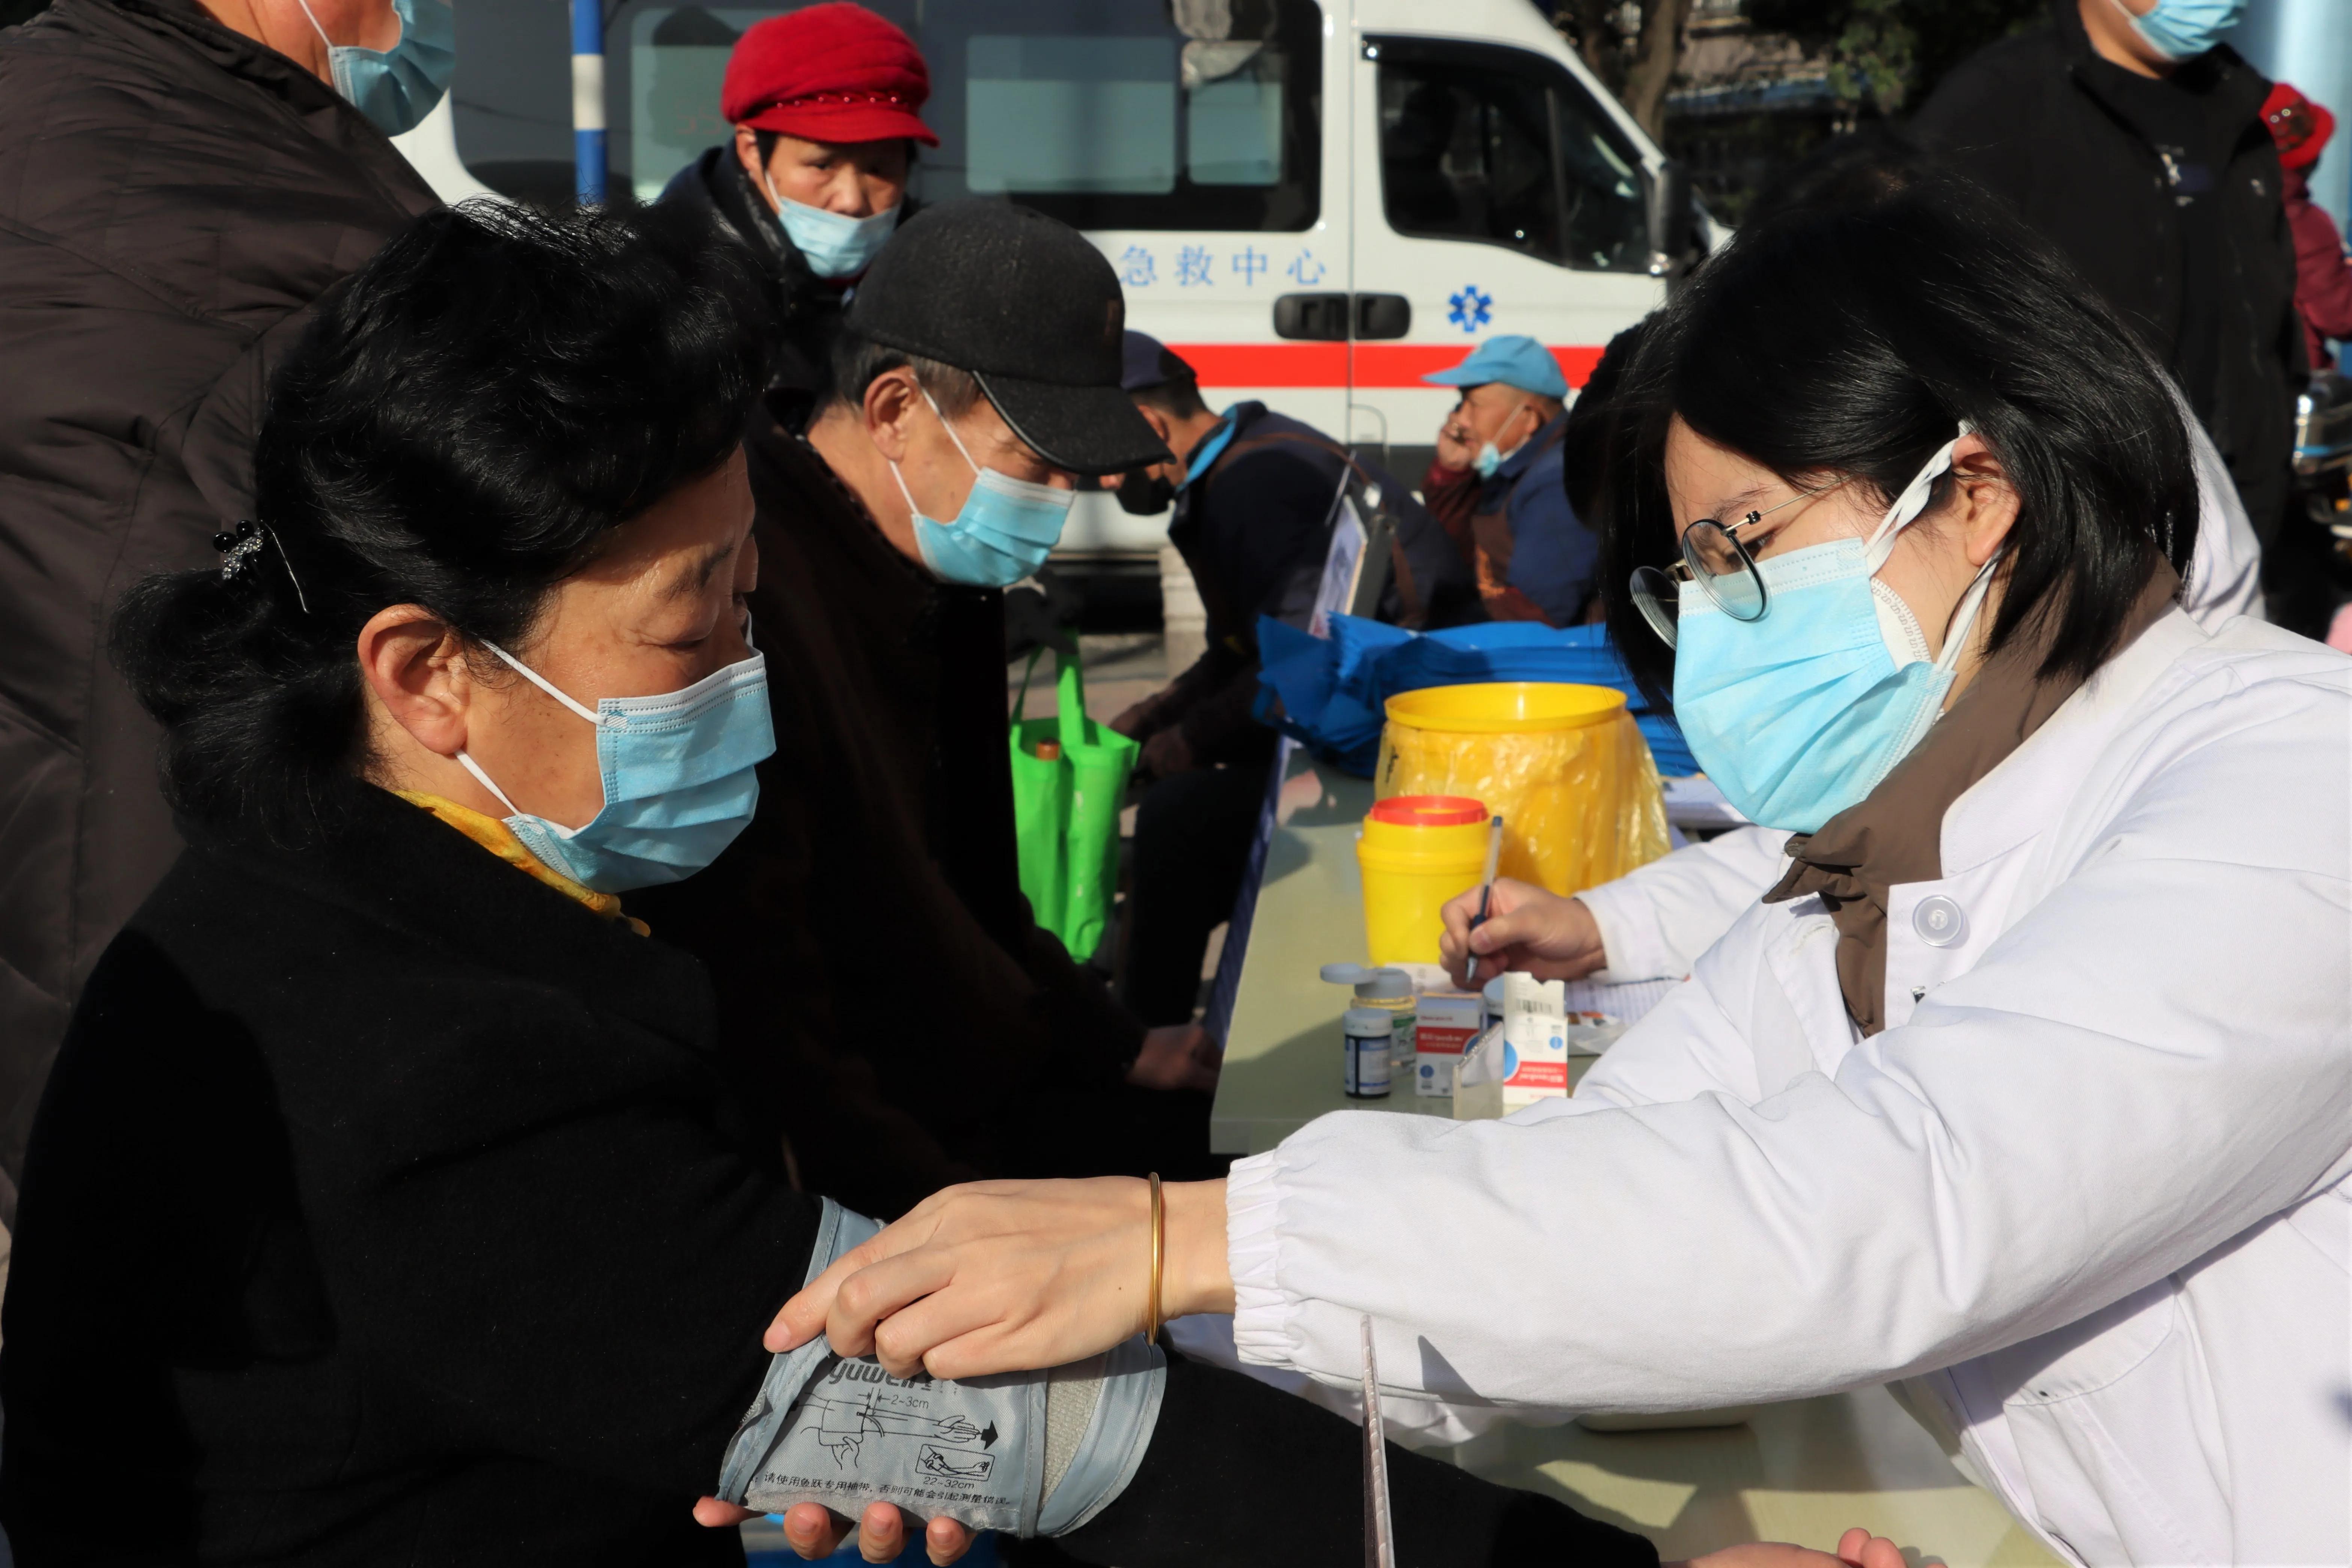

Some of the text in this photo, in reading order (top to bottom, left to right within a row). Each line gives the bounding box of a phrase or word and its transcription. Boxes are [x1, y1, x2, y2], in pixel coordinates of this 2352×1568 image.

[1121, 244, 1325, 286] 急救中心
[923, 1476, 975, 1489] 22~32cm
